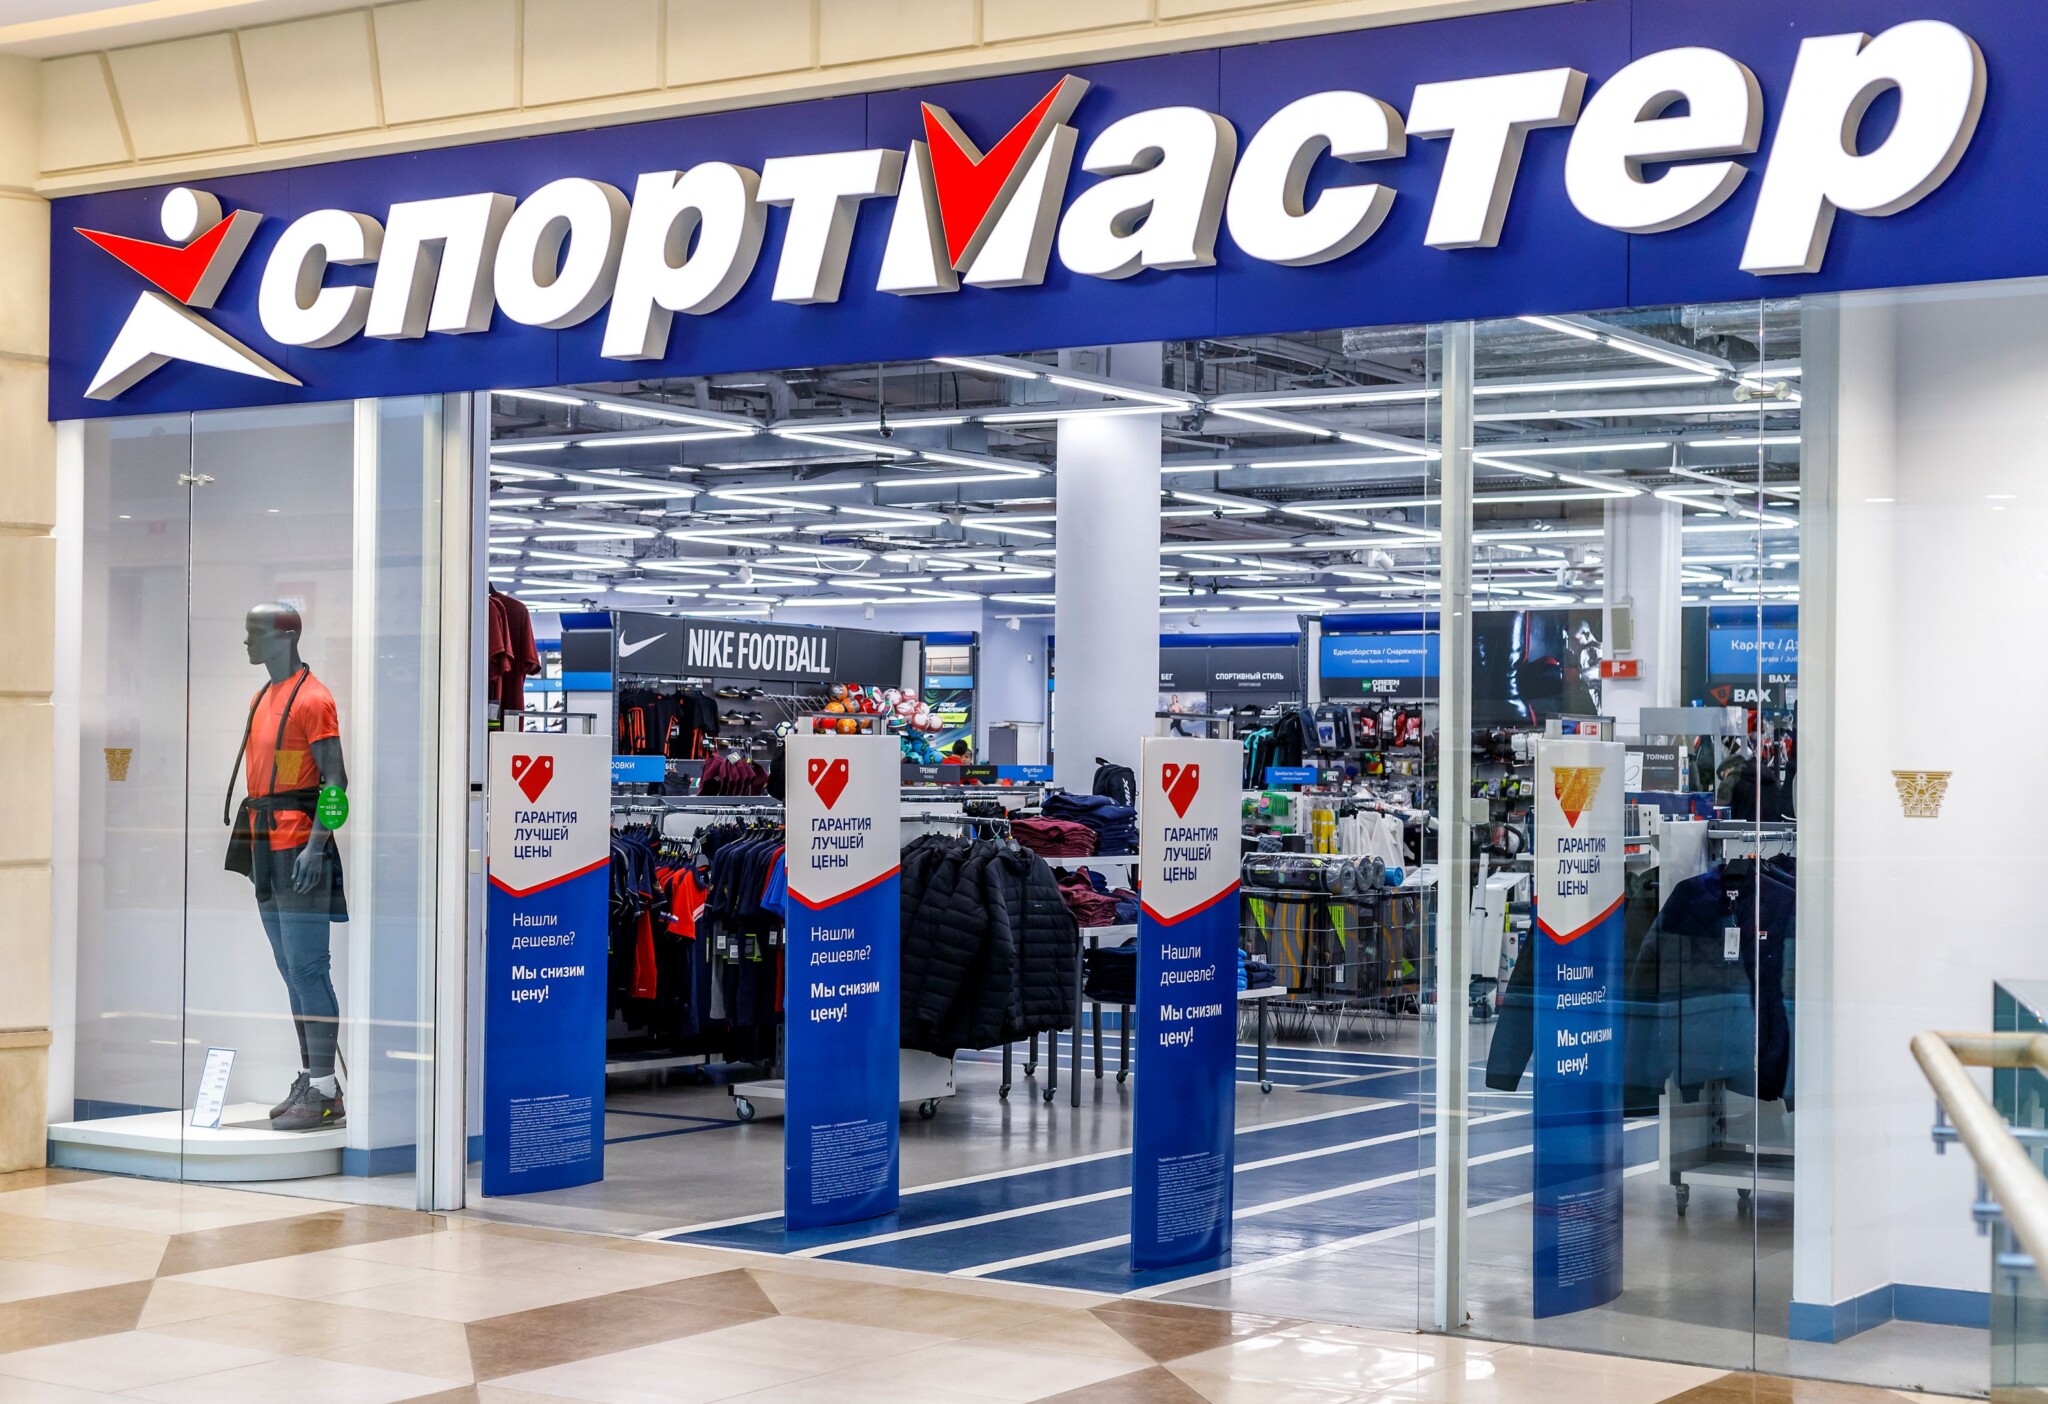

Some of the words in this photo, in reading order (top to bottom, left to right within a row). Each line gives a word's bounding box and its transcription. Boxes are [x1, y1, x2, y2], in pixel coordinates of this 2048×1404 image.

[688, 628, 735, 668] NIKE
[737, 632, 831, 673] FOOTBALL
[1333, 648, 1381, 656] Единоборства
[1215, 672, 1260, 680] СПОРТИВНЫЙ
[1733, 689, 1771, 702] BAX
[515, 810, 577, 825] ГАРАНТИЯ
[812, 818, 870, 831] ГАРАНТИЯ
[515, 826, 568, 840] ЛУЧШЕЙ
[812, 833, 863, 849] ЛУЧШЕЙ
[1165, 828, 1217, 841] ГАРАНТИЯ
[515, 846, 551, 859] ЦЕНЫ
[1164, 844, 1210, 861] ЛУЧШЕЙ
[1558, 838, 1605, 852] ГАРАНТИЯ
[812, 855, 848, 870] ЦЕНЫ
[1558, 856, 1600, 874] ЛУЧШЕЙ
[1164, 867, 1196, 883] ЦЕНЫ
[1558, 881, 1588, 897] ЦЕНЫ
[513, 913, 557, 926] Нашли
[512, 932, 575, 949] дешевле?
[812, 927, 854, 941] Нашли
[811, 945, 871, 966] дешевле?
[1162, 945, 1200, 959] Нашли
[513, 966, 536, 979] Мы
[541, 966, 584, 978] снизим
[1161, 965, 1215, 986] дешевле?
[1558, 964, 1593, 980] Нашли
[512, 985, 548, 1003] цену!
[812, 983, 834, 998] Мы
[839, 982, 879, 996] снизим
[1557, 986, 1605, 1009] дешевле?
[811, 1003, 847, 1022] цену!
[1161, 1005, 1182, 1021] Мы
[1186, 1004, 1221, 1019] снизим
[1161, 1027, 1193, 1047] цену!
[1558, 1030, 1577, 1047] Мы
[1581, 1028, 1611, 1044] снизим
[1558, 1053, 1587, 1075] цену!
